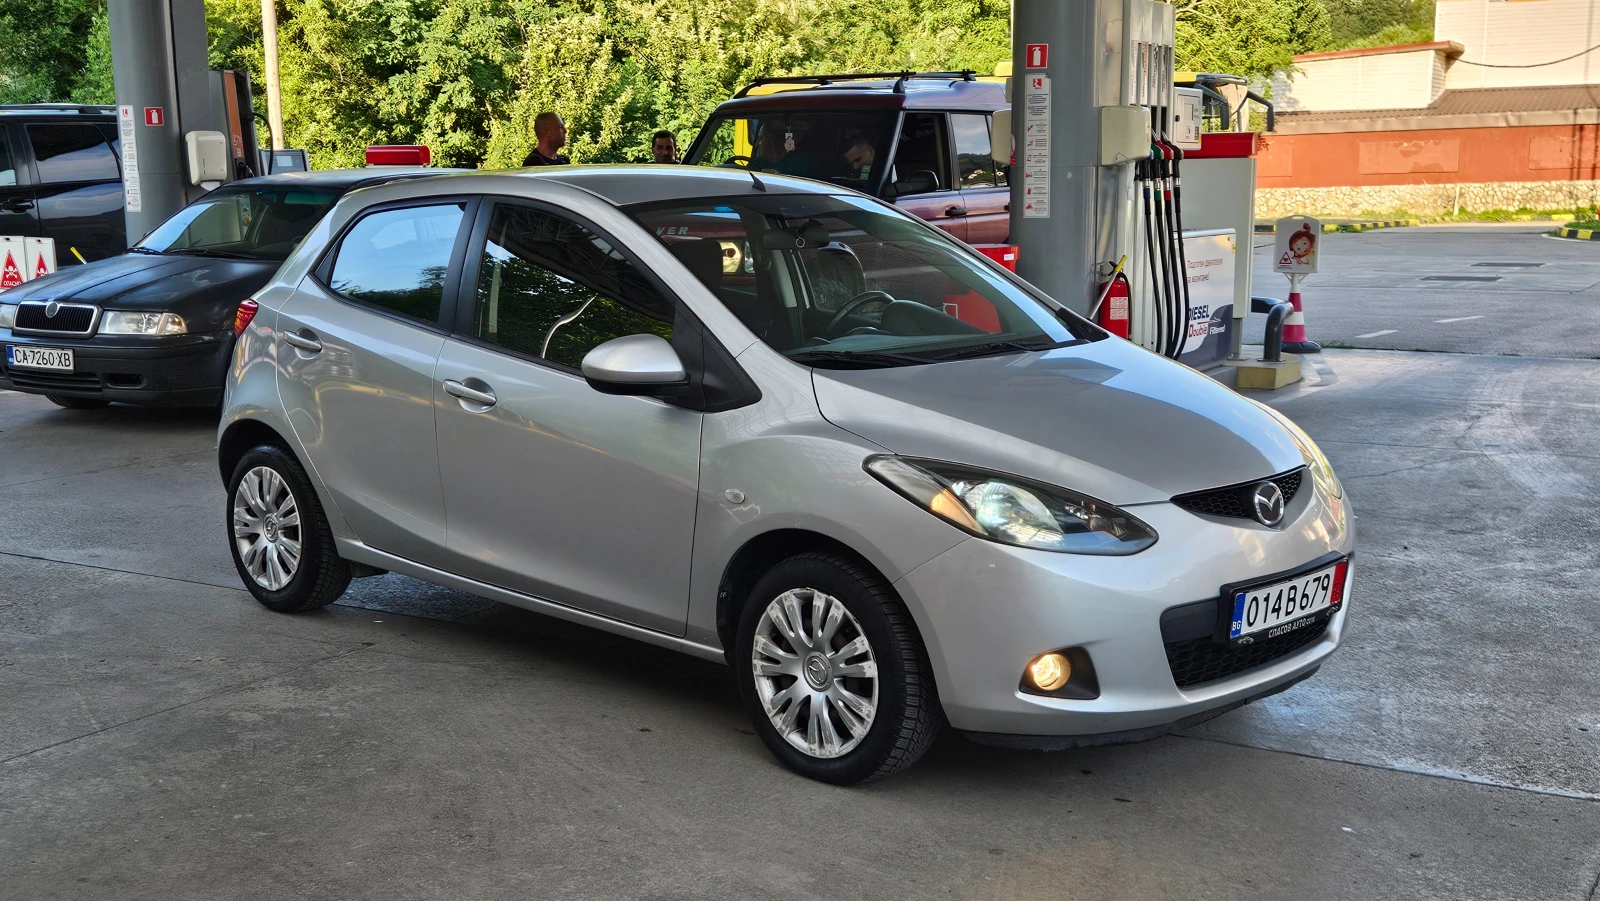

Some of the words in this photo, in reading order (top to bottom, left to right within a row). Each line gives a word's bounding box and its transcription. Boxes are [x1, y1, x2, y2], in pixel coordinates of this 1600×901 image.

[1188, 324, 1207, 338] Double
[1232, 620, 1242, 631] BG
[1247, 573, 1330, 627] 014B679
